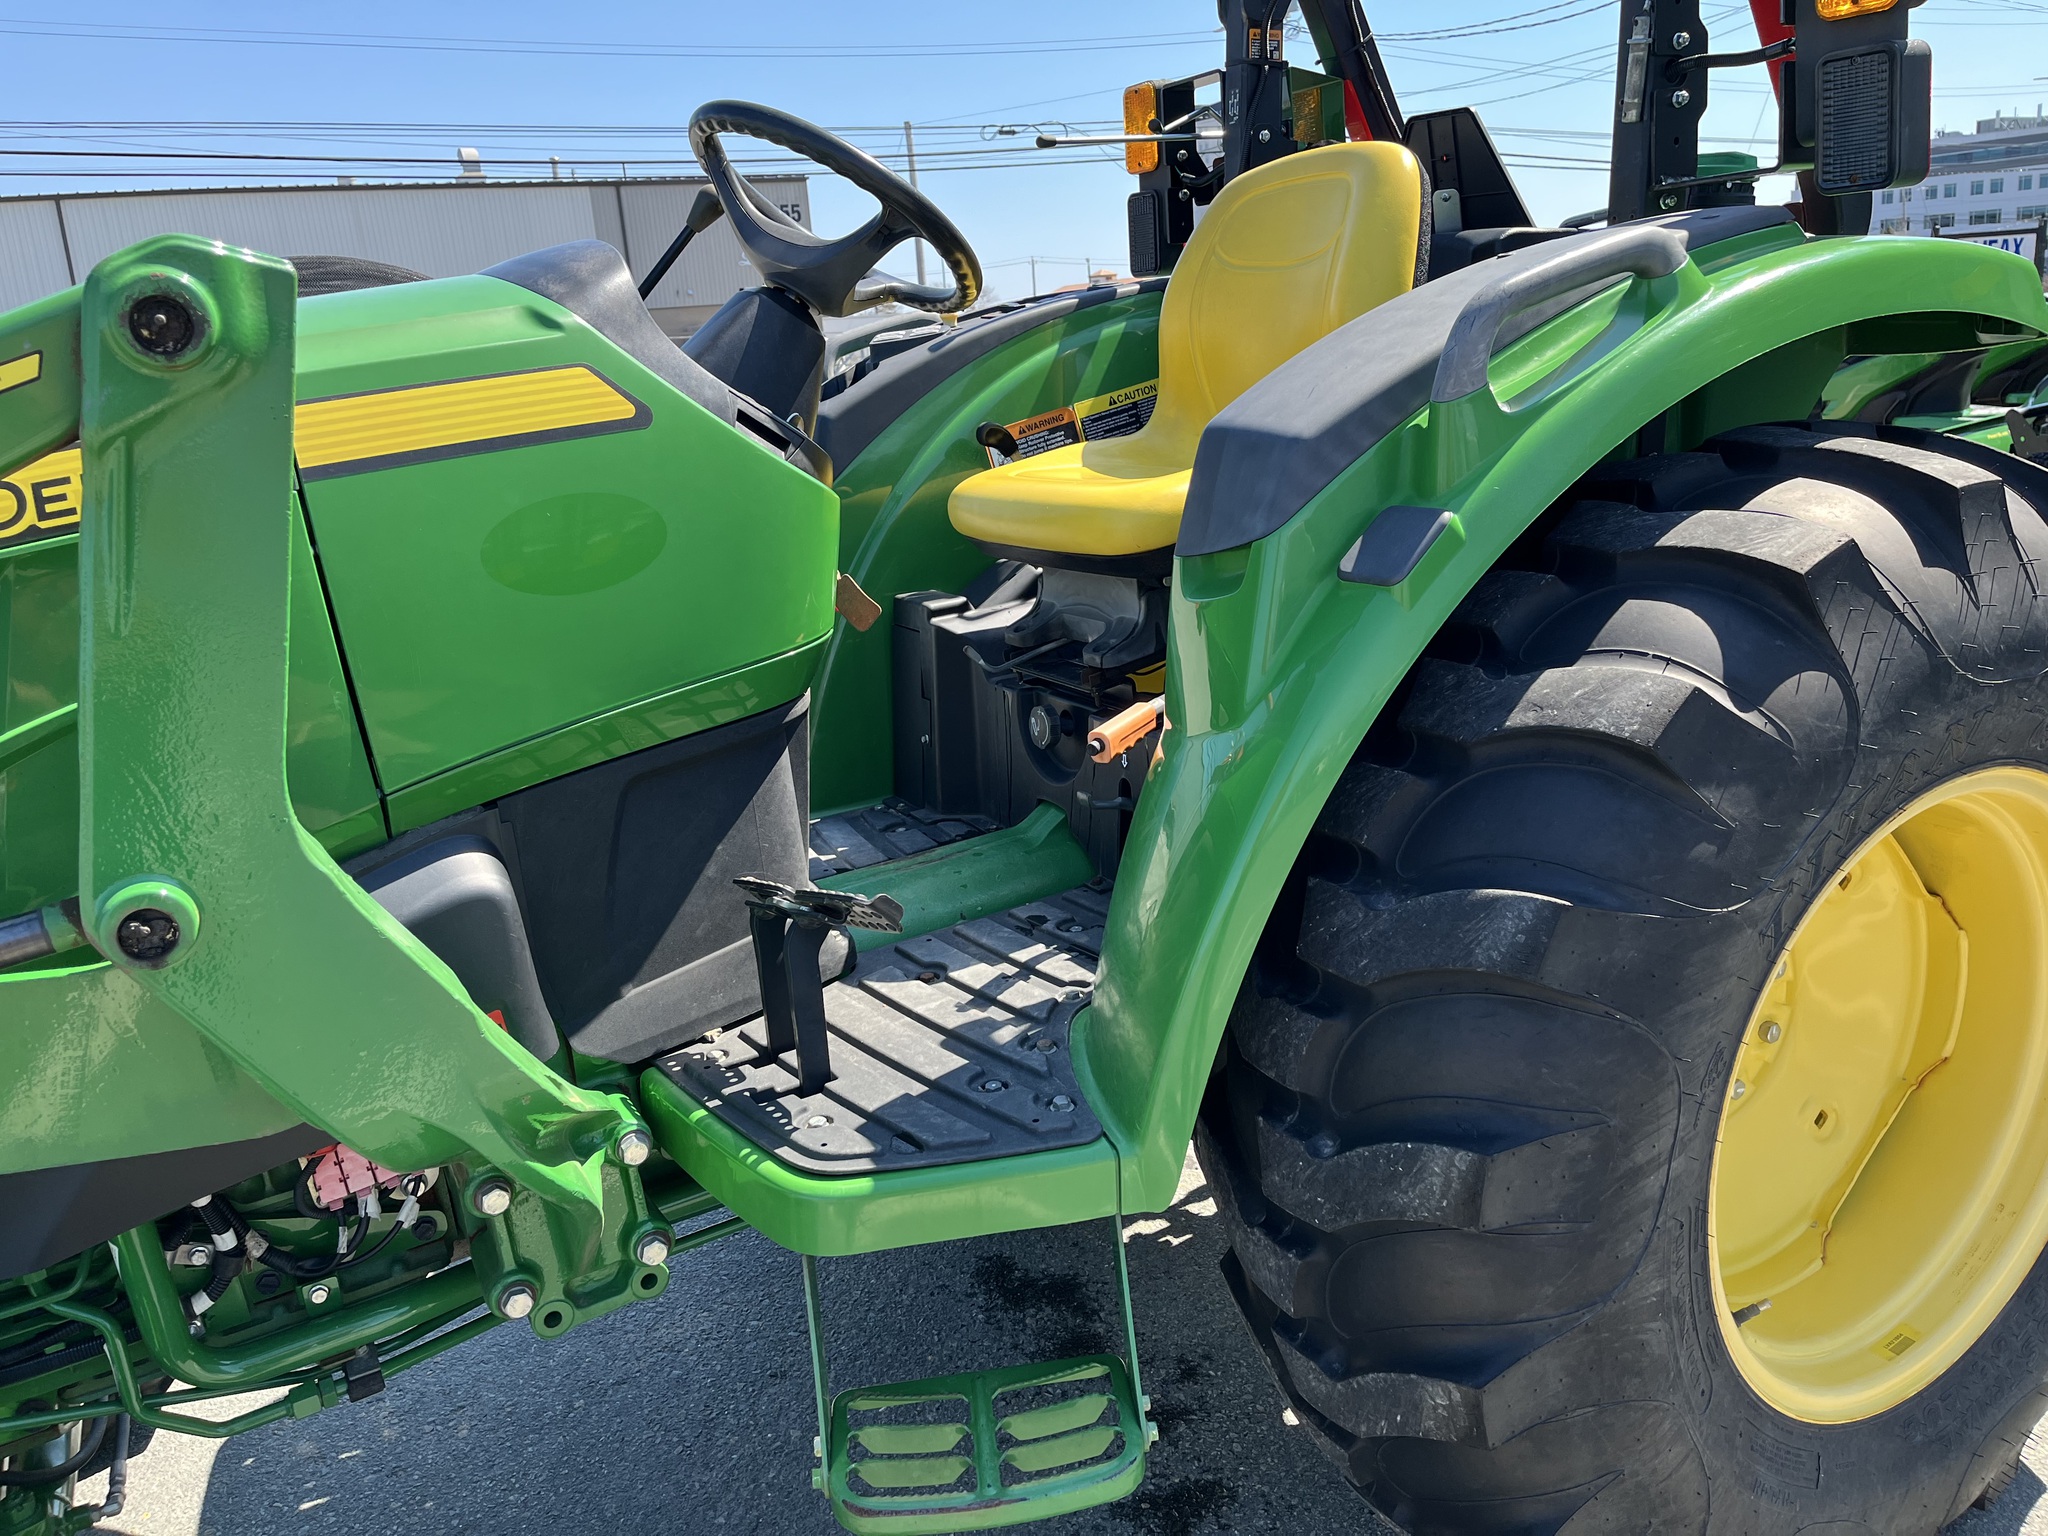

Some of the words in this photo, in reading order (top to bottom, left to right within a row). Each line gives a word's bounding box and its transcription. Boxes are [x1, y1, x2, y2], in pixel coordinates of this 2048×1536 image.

[1116, 384, 1157, 403] CAUTION
[1025, 413, 1065, 432] WARNING
[0, 475, 83, 530] DE
